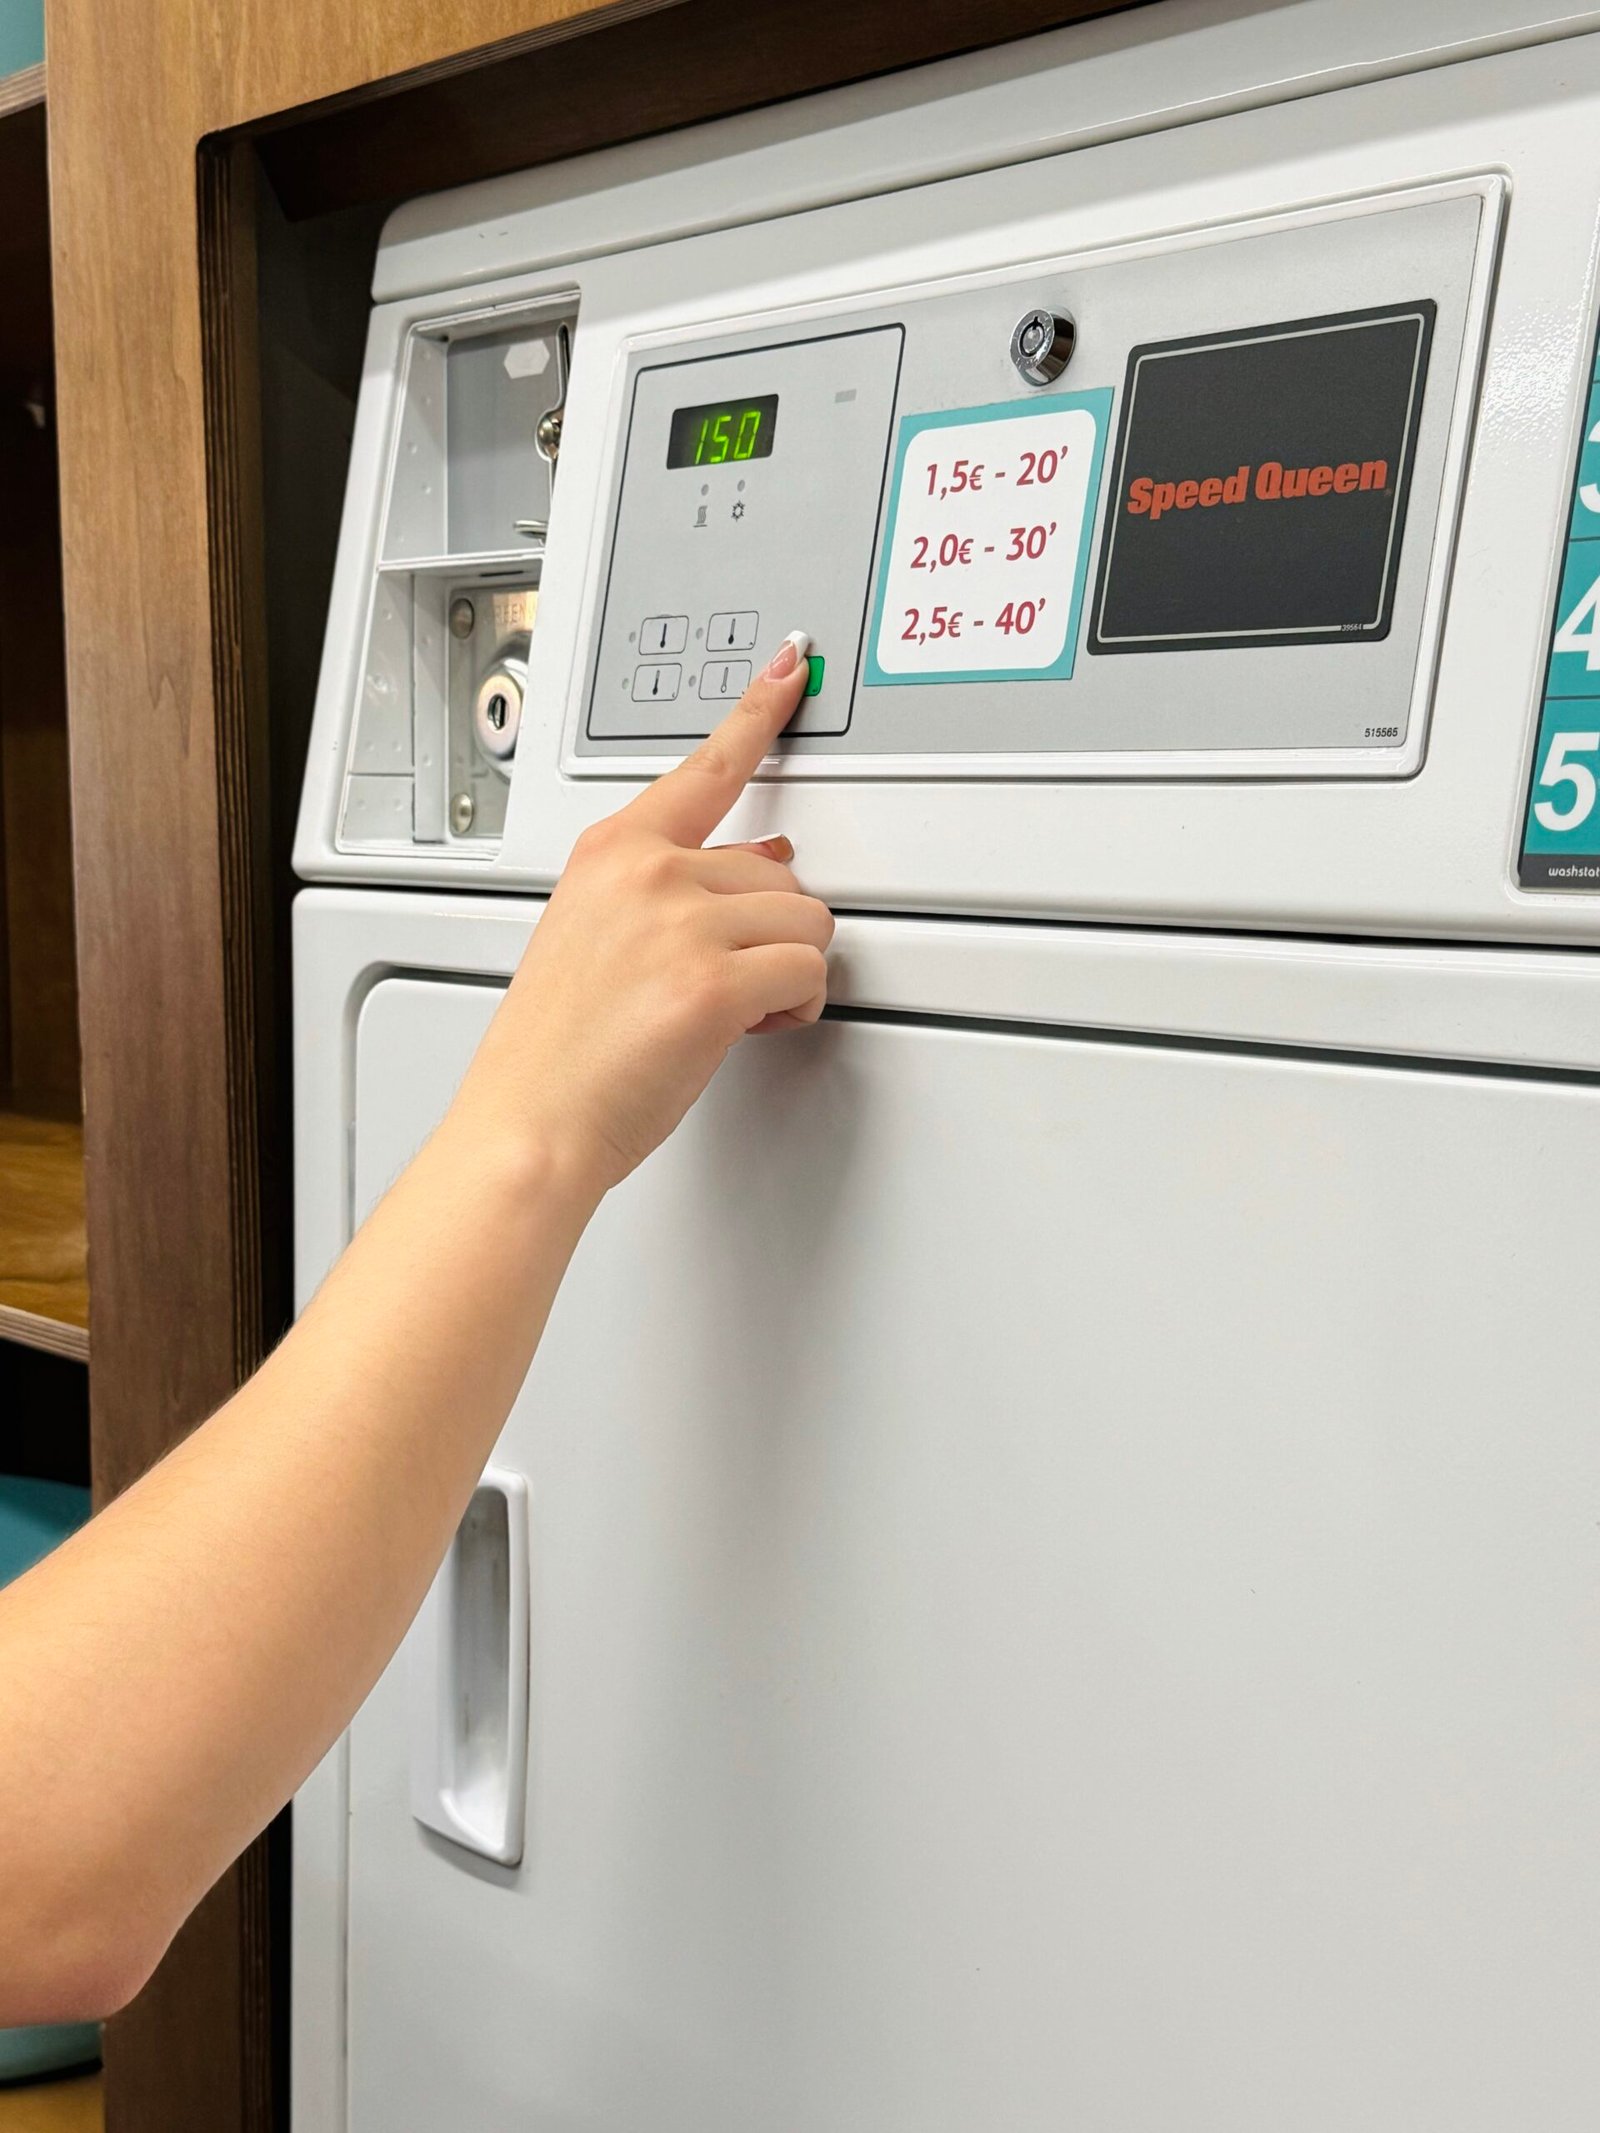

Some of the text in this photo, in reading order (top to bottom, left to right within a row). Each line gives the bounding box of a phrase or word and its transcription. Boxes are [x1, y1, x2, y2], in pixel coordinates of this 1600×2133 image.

[695, 411, 760, 464] 150
[927, 460, 985, 500] 1,5€
[1127, 460, 1388, 520] Speed Queen
[910, 534, 974, 573] 2,0€
[901, 606, 963, 646] 2,5€
[1533, 732, 1600, 831] 5
